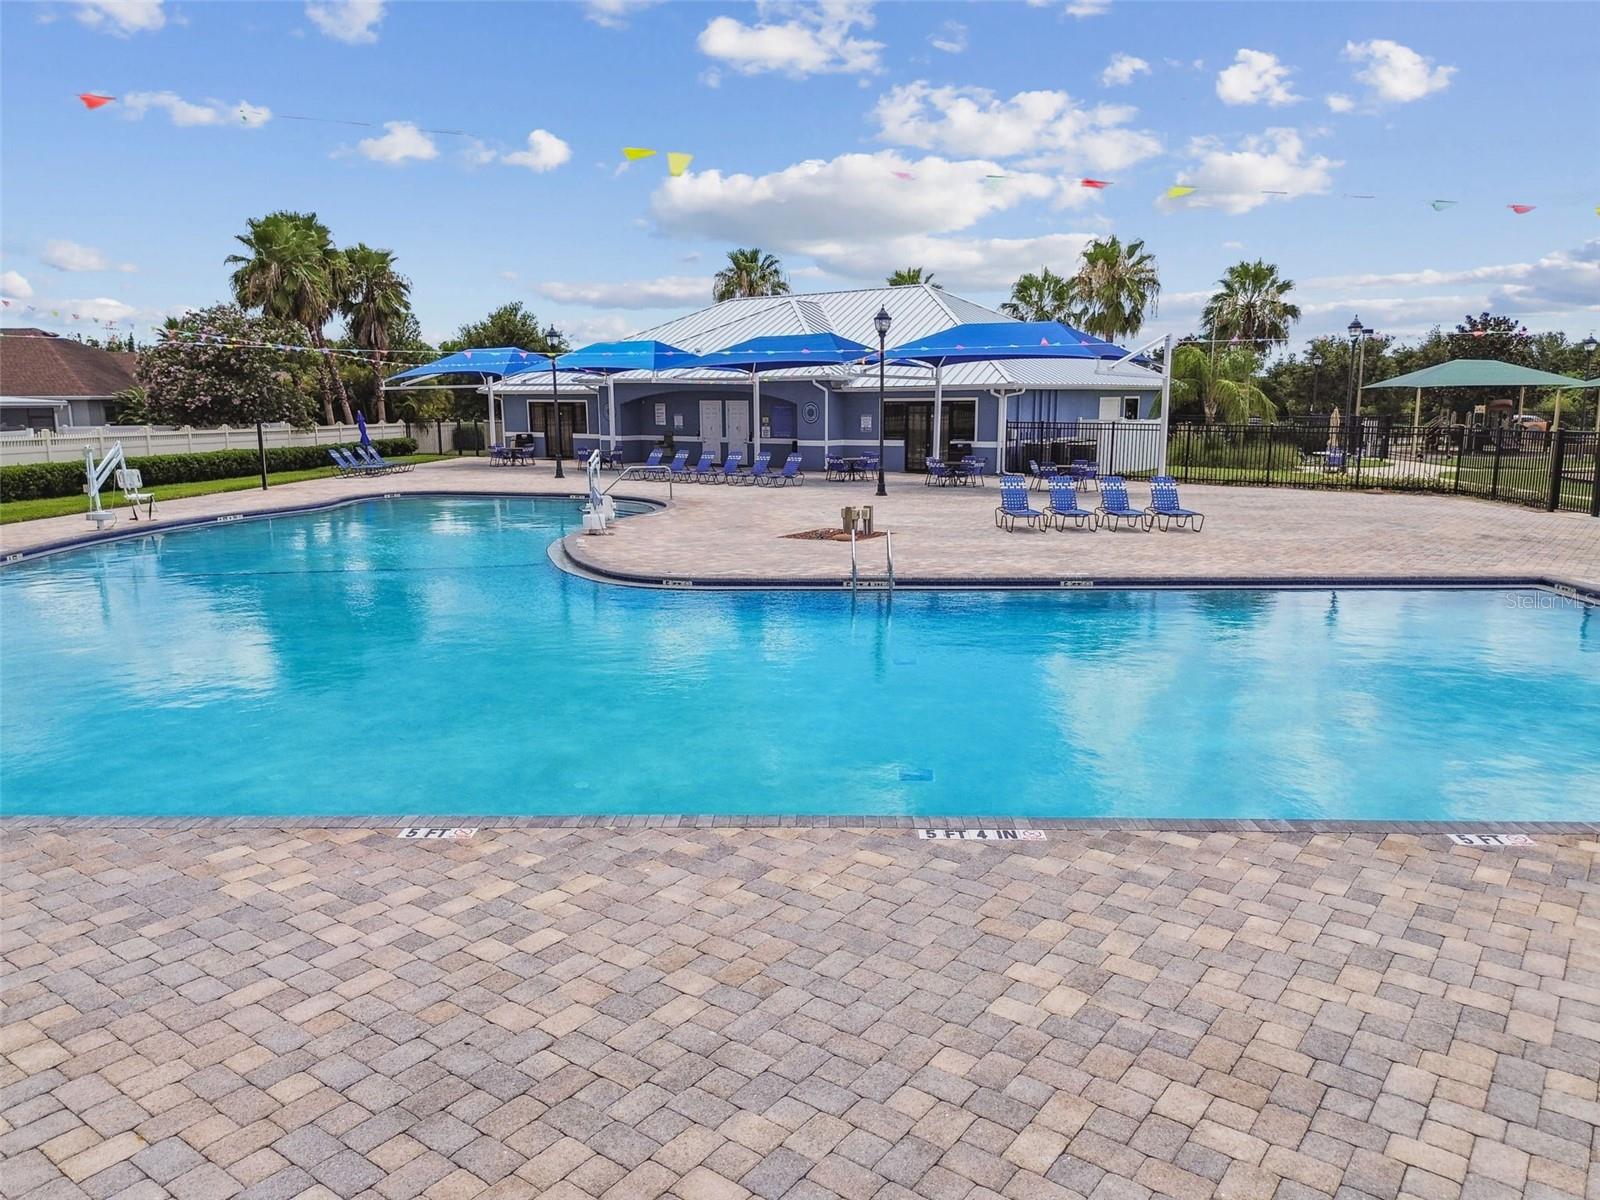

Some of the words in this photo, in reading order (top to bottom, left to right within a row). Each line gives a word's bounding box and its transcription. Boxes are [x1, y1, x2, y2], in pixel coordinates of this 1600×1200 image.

[405, 828, 419, 838] 5
[424, 828, 451, 838] FT
[926, 829, 937, 839] 5
[945, 829, 967, 839] FT
[976, 829, 987, 839] 4
[997, 830, 1018, 840] IN
[1455, 834, 1474, 844] 5
[1475, 834, 1504, 845] FT
